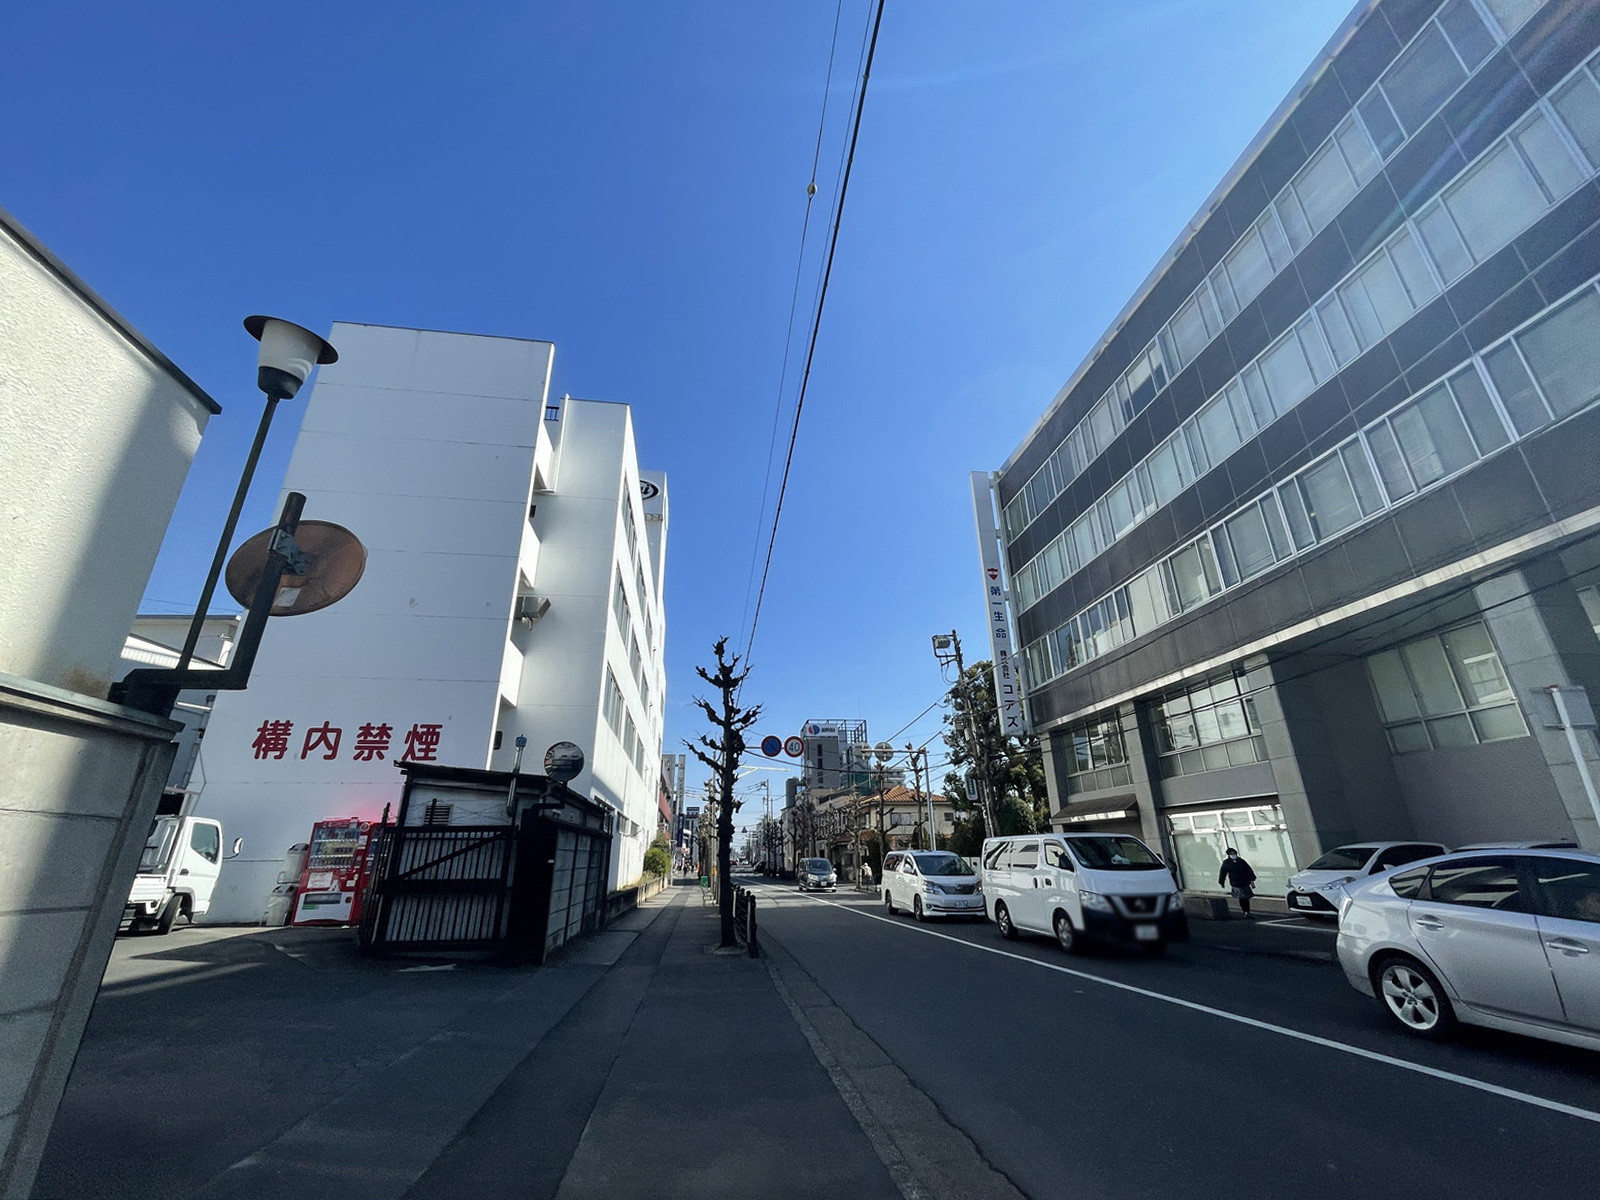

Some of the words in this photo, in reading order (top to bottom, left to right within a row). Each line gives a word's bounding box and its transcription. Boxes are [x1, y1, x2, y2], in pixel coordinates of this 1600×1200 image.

[990, 586, 1007, 639] 第一生命
[252, 719, 443, 762] 構内禁煙
[788, 741, 801, 752] 40
